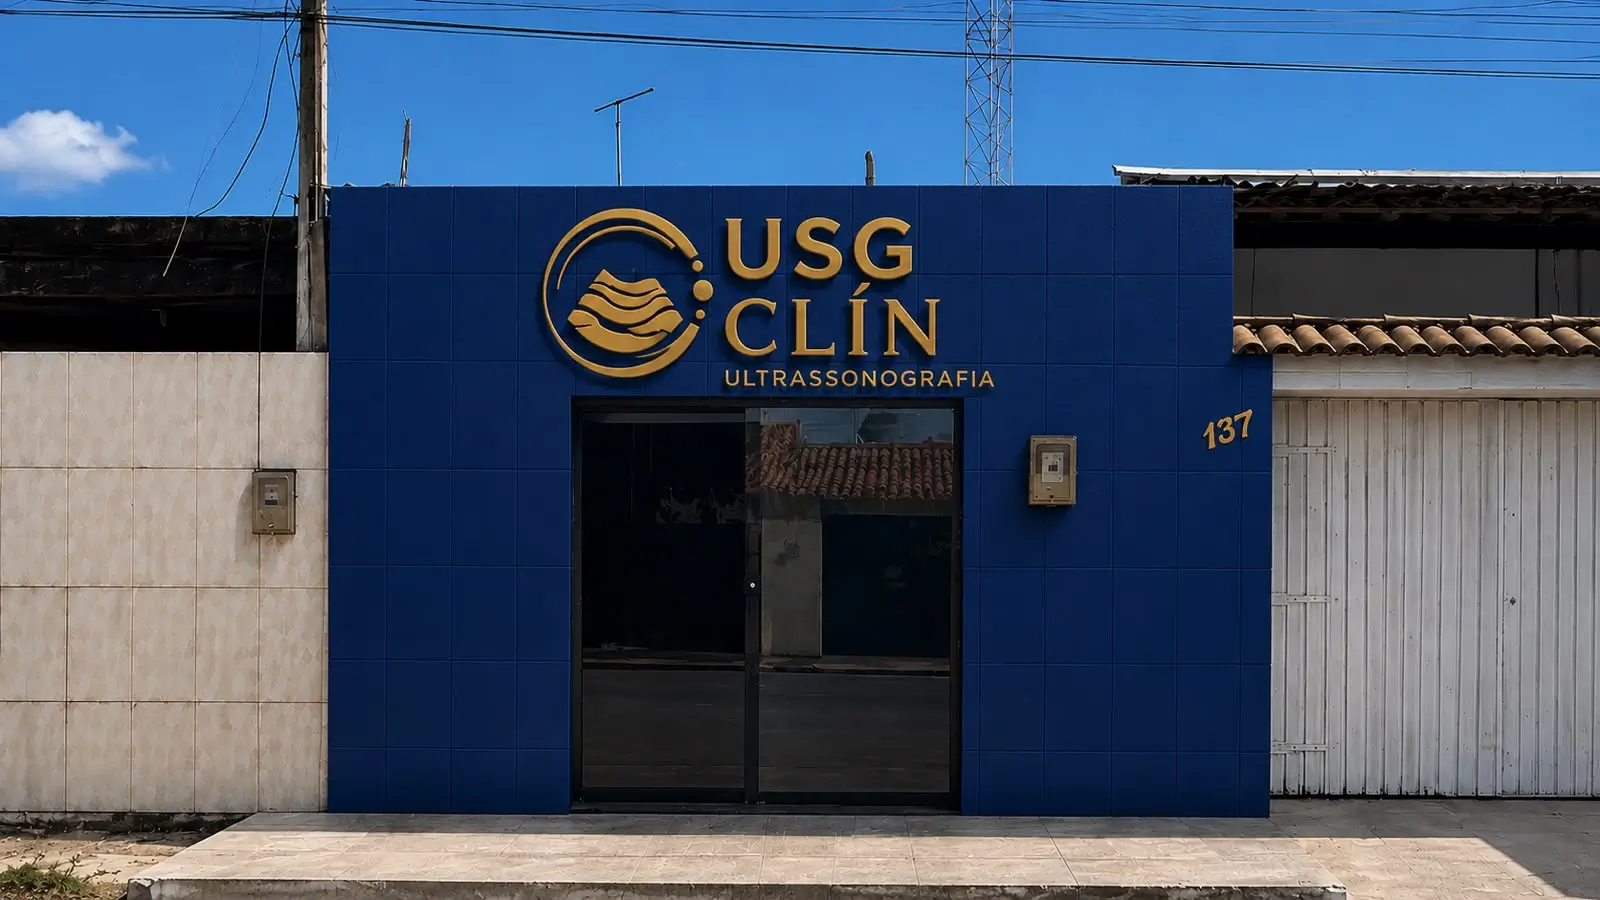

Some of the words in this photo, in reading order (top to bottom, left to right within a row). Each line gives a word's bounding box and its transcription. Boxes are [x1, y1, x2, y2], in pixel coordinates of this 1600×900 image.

[725, 217, 913, 280] USG
[725, 282, 940, 357] CLÍN
[725, 369, 994, 388] ULTRASSONOGRAFIA
[1203, 409, 1253, 449] 137
